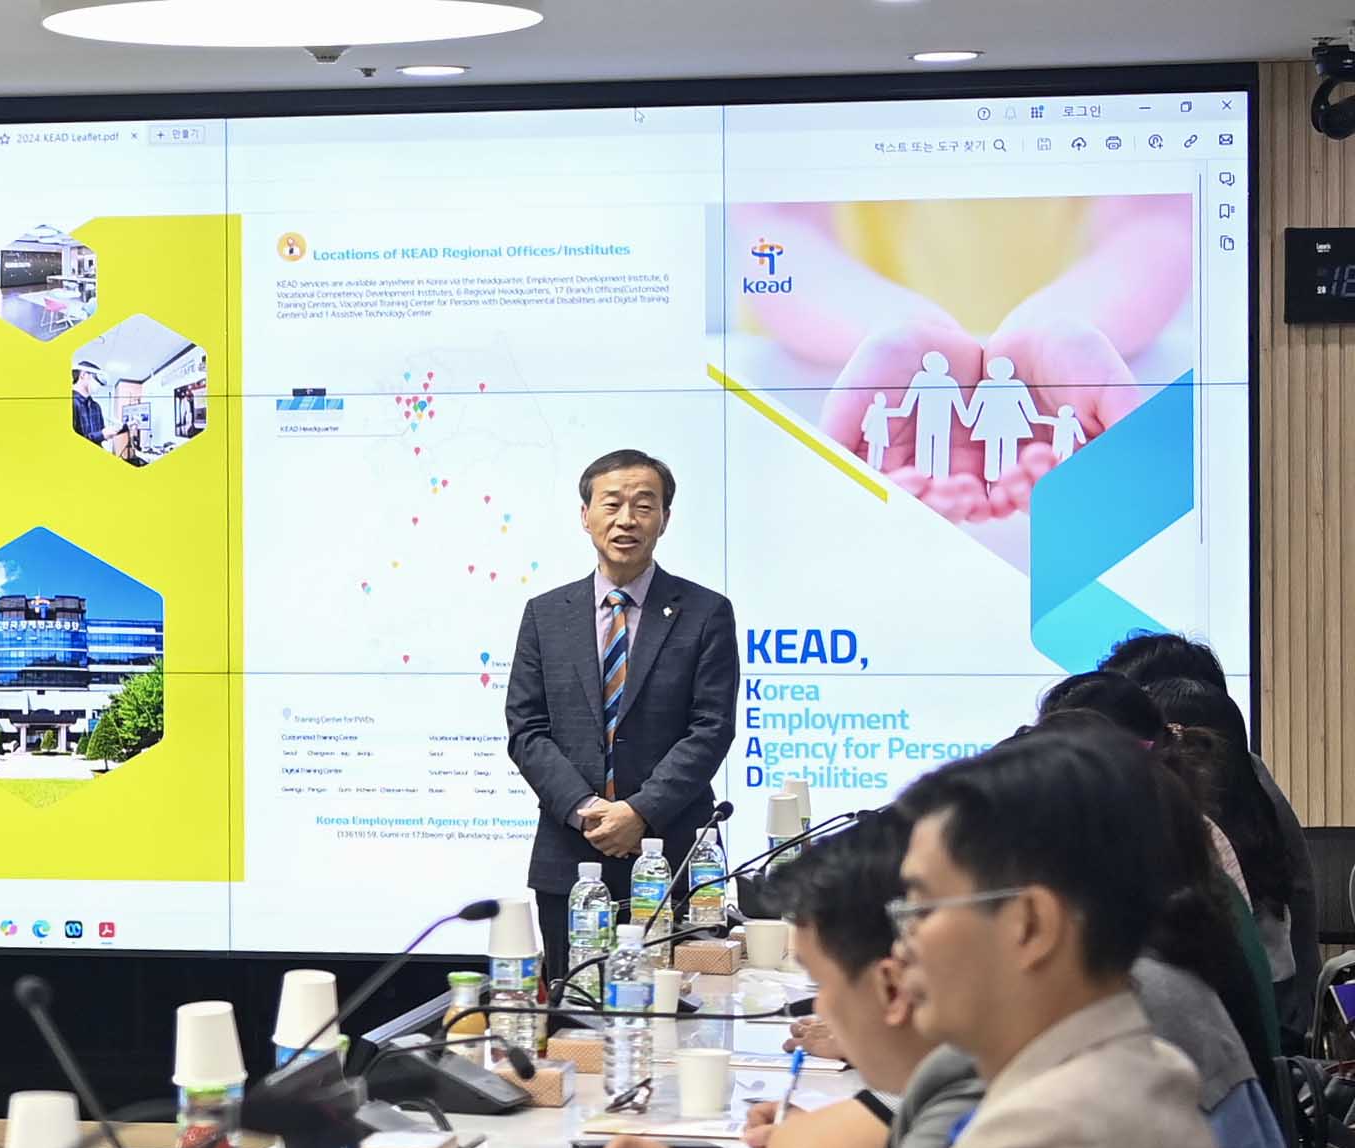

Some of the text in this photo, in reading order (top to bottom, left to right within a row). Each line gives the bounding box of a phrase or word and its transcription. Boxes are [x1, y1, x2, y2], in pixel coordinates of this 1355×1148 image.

[1062, 105, 1101, 118] 로그인
[17, 131, 119, 144] 2024 KEAD Leaflet.pdf
[911, 141, 933, 152] 또는
[937, 141, 959, 151] 도구
[313, 244, 631, 261] Locations of KEAD Regional Offices/Institutes
[276, 280, 298, 289] KEAD
[743, 276, 792, 294] kead
[746, 629, 869, 671] KEAD,
[746, 679, 820, 701] Korea
[746, 707, 910, 735] Employment
[746, 737, 838, 766] Agency
[844, 737, 882, 759] for
[316, 815, 349, 826] Korea
[352, 815, 424, 828] Employment
[427, 816, 469, 828] Agency
[472, 815, 489, 826] for
